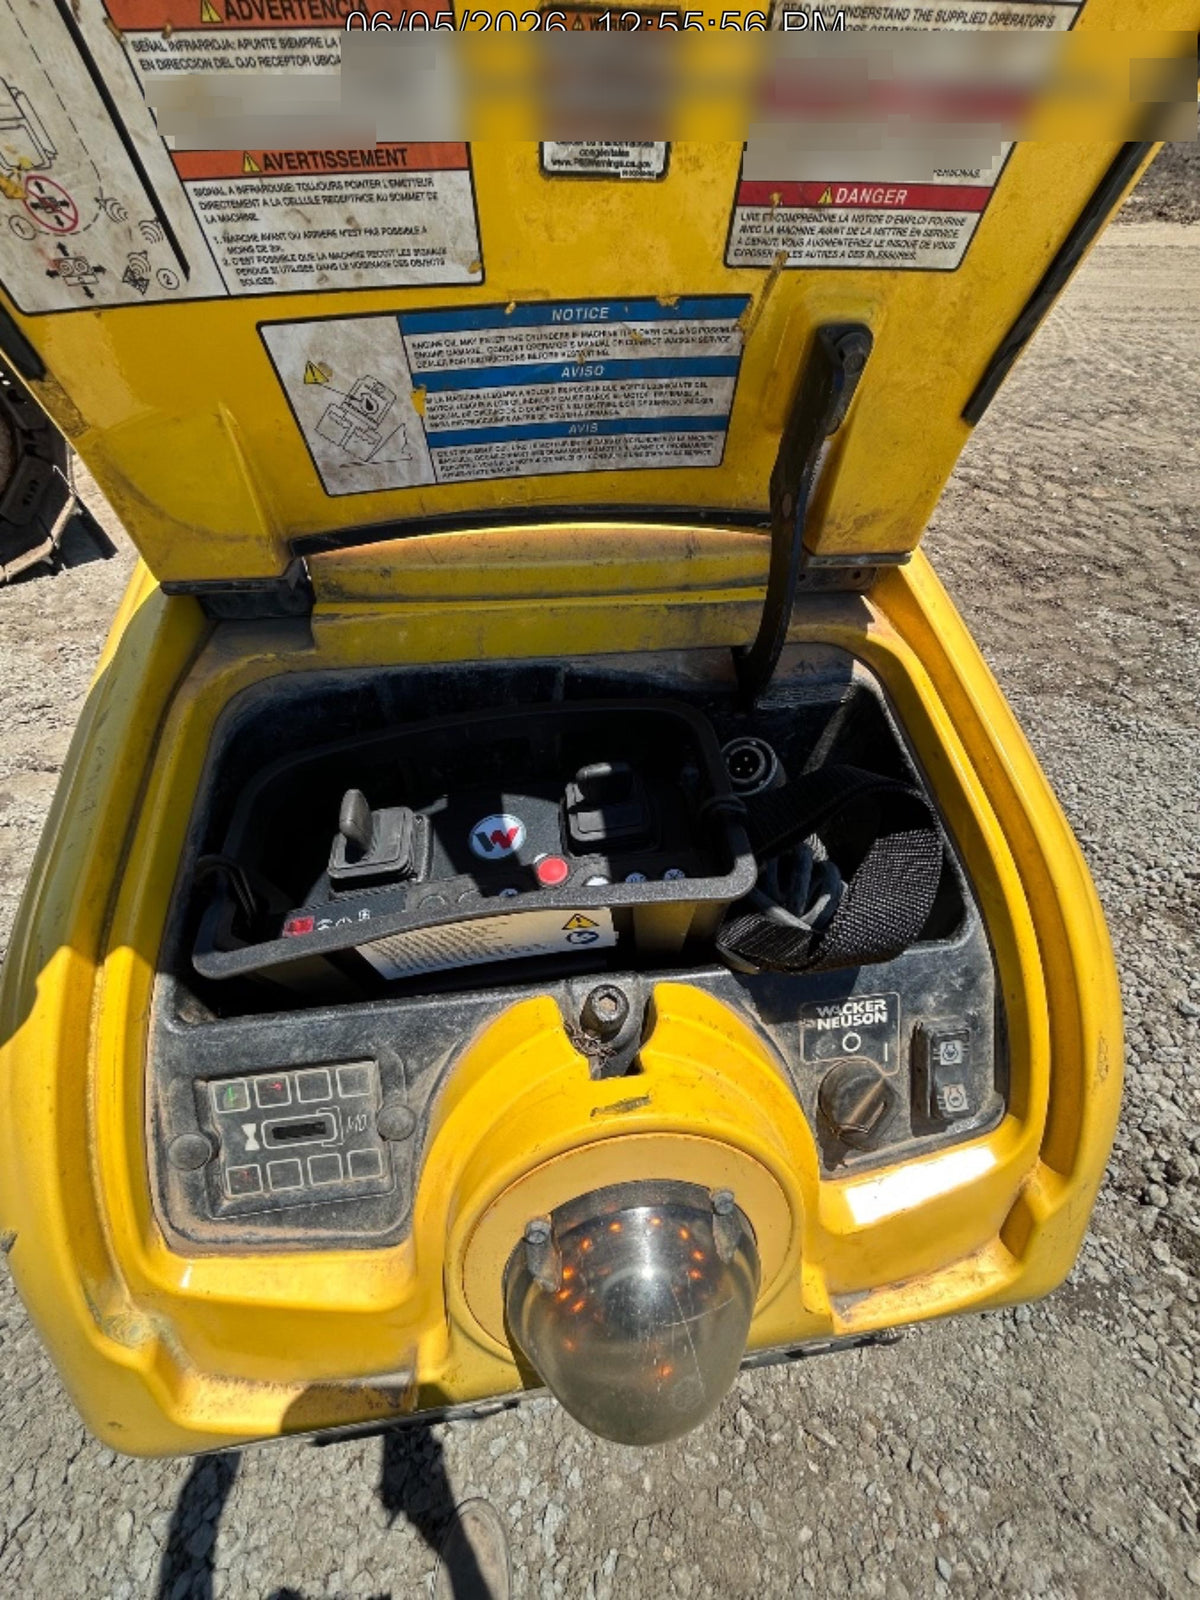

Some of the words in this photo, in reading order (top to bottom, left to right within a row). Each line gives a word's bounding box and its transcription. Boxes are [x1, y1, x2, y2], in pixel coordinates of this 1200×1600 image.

[914, 9, 933, 22] THE
[935, 9, 987, 25] SUPPLIED
[237, 37, 277, 50] APUNTE
[325, 37, 338, 48] LA
[139, 58, 155, 71] EN
[213, 56, 234, 69] DEL
[235, 56, 256, 68] OJO
[257, 55, 311, 67] RECEPTOR
[262, 148, 408, 171] AVERTISSEMENT
[270, 197, 282, 206] LA
[834, 187, 908, 206] DANGER
[204, 214, 216, 224] LA
[552, 306, 610, 321] NOTICE
[561, 364, 604, 378] AVISO
[568, 422, 598, 434] AVIS
[816, 999, 888, 1017] WACKER
[817, 1011, 887, 1031] NEUSON
